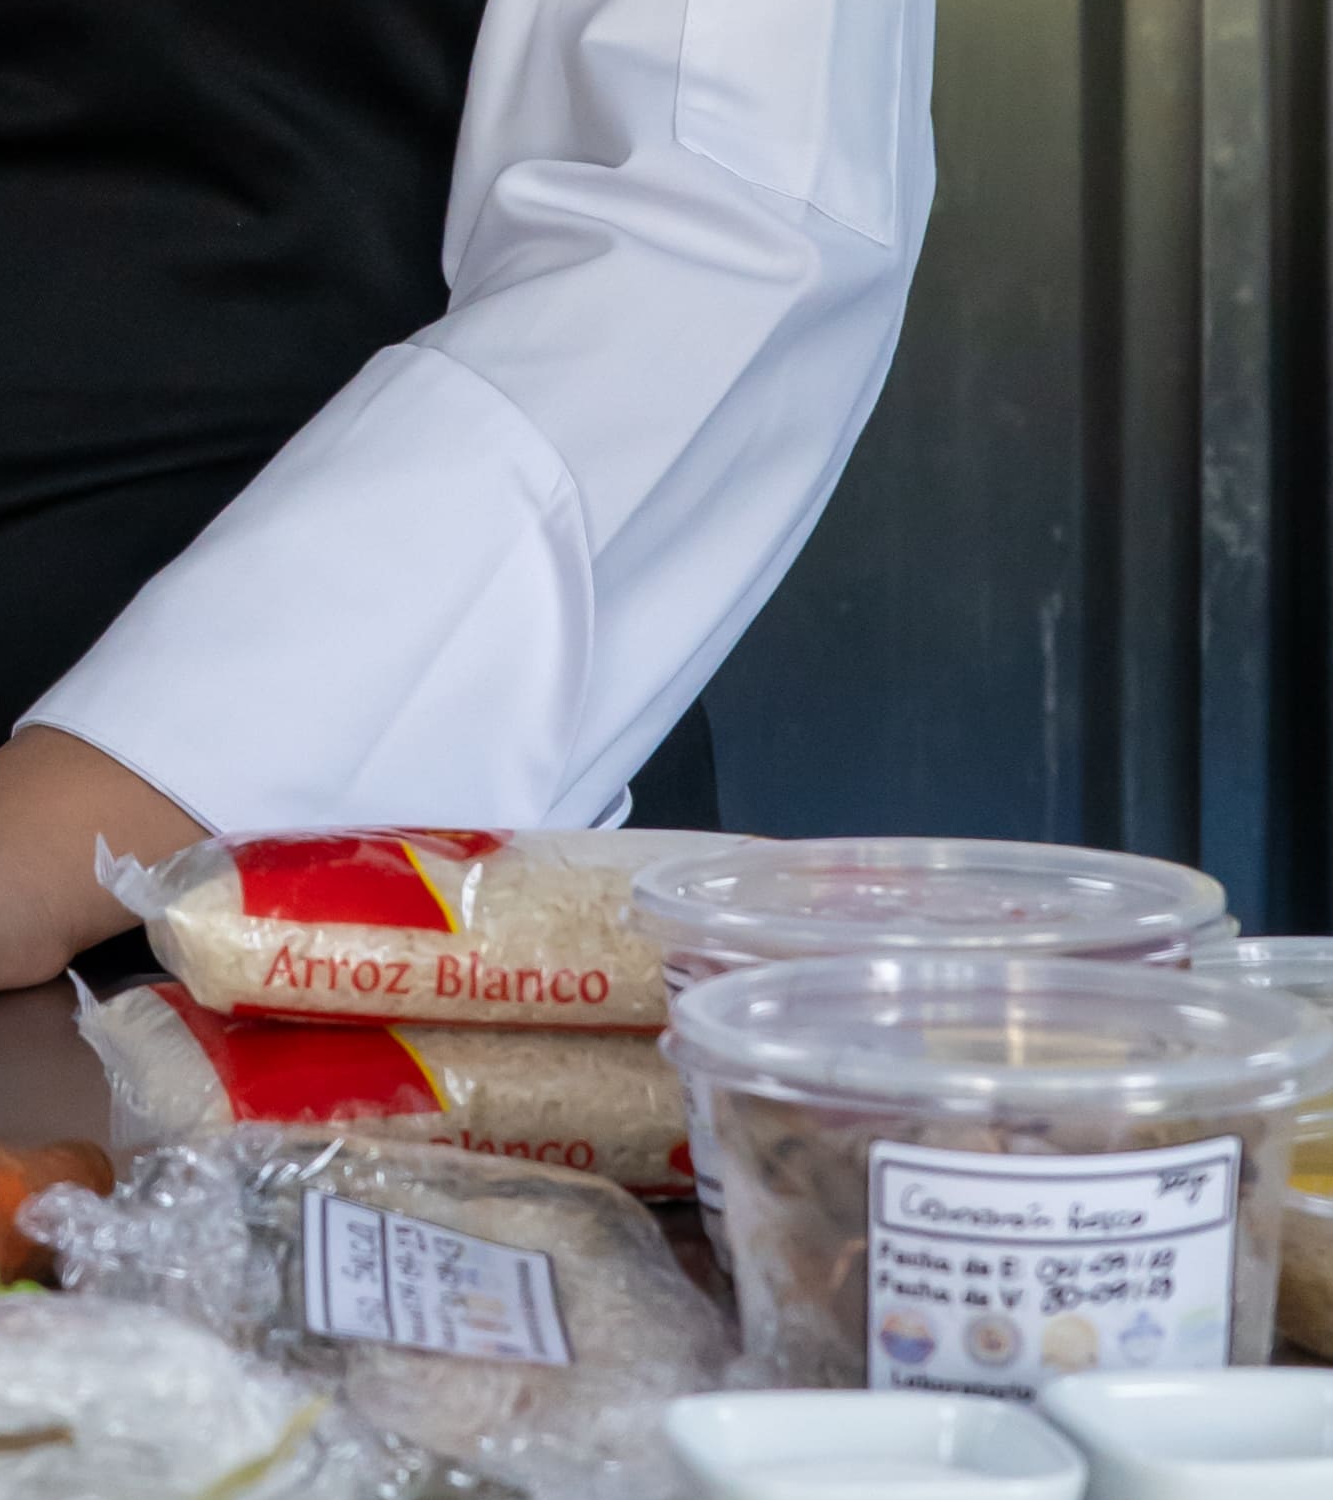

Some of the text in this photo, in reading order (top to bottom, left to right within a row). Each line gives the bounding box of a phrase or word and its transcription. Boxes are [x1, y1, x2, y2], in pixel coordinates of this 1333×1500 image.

[263, 944, 611, 1005] Arroz Blanco
[429, 1130, 596, 1171] lanco
